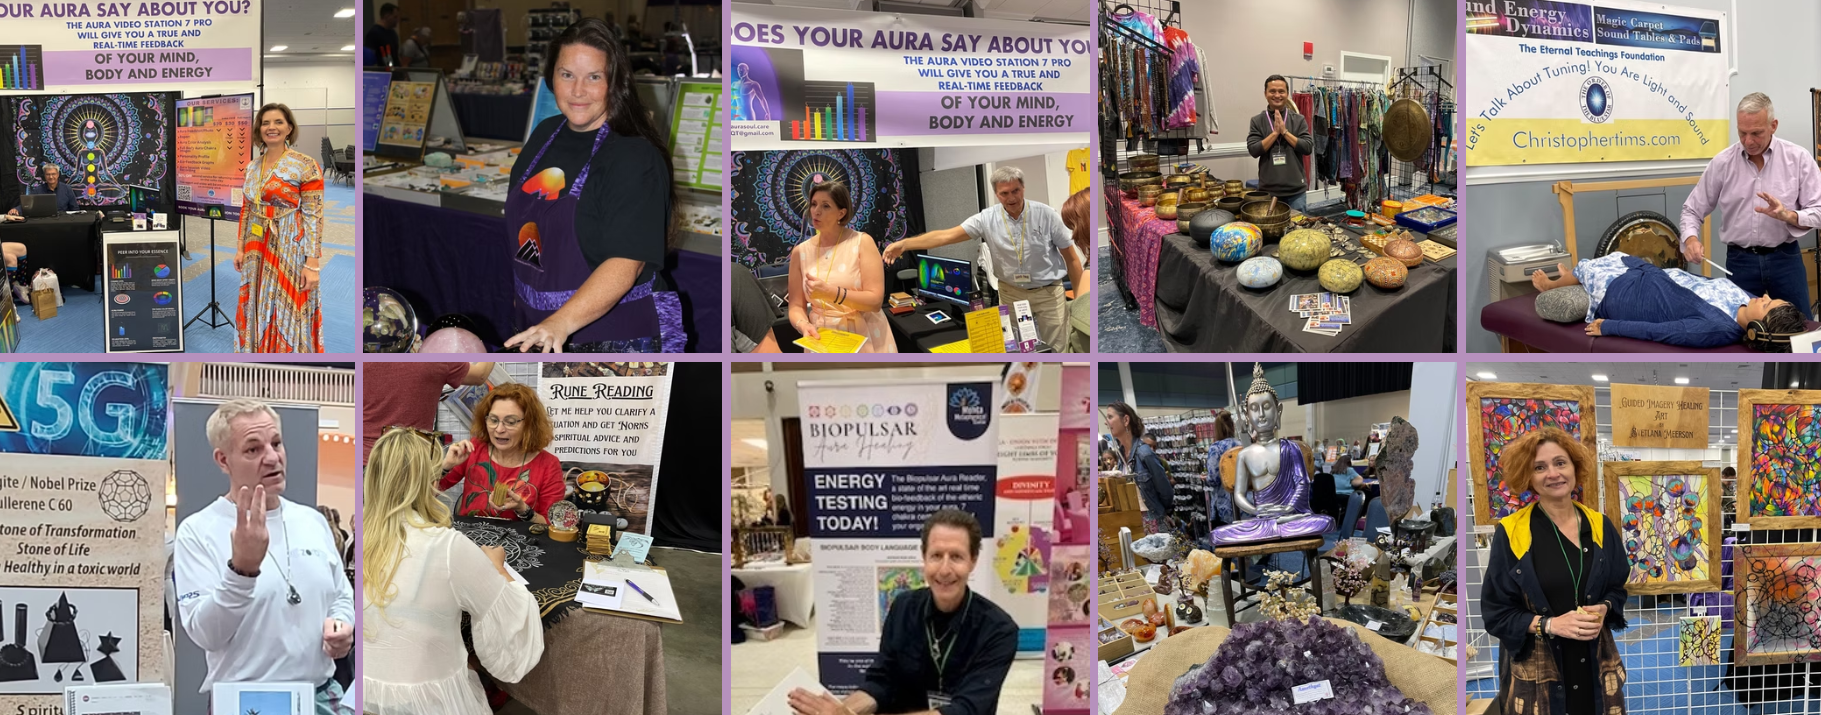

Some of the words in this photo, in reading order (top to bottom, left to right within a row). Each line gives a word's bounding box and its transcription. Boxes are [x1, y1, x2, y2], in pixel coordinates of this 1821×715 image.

[40, 3, 91, 17] AURA
[97, 3, 131, 17] SAY
[137, 2, 197, 16] ABOUT
[203, 0, 251, 14] YOU?
[1504, 0, 1566, 24] Energy
[114, 21, 142, 29] VIDEO
[145, 20, 182, 28] STATION
[1506, 17, 1589, 38] Dynamics
[1596, 14, 1627, 28] Magic
[1630, 18, 1663, 31] Carpet
[101, 31, 122, 39] GIVE
[157, 30, 178, 38] TRUE
[731, 22, 785, 44] OES
[793, 26, 863, 48] YOUR
[871, 30, 933, 51] AURA
[941, 33, 982, 53] SAY
[987, 36, 1052, 54] ABOUT
[1597, 27, 1629, 40] Sound
[1632, 31, 1665, 42] Tables
[1668, 34, 1676, 43] &
[1679, 34, 1700, 46] Pads
[93, 41, 138, 49] REAL-TIME
[141, 40, 184, 48] FEEDBACK
[95, 53, 112, 64] OF
[117, 53, 155, 64] YOUR
[160, 52, 199, 64] MIND,
[1519, 44, 1537, 53] The
[1540, 45, 1572, 55] Eternal
[1576, 47, 1618, 60] Teachings
[1621, 51, 1665, 61] Foundation
[903, 56, 923, 65] THE
[927, 57, 957, 66] AURA
[960, 57, 993, 66] VIDEO
[996, 58, 1039, 67] STATION
[1051, 59, 1071, 67] PRO
[86, 69, 123, 80] BODY
[128, 68, 157, 79] AND
[162, 67, 213, 78] ENERGY
[918, 69, 944, 77] WILL
[947, 69, 971, 78] GIVE
[975, 70, 997, 78] YOU
[1001, 70, 1009, 78] A
[1011, 70, 1036, 78] TRUE
[1039, 70, 1060, 78] AND
[938, 82, 991, 90] REAL-TIME
[994, 82, 1043, 90] FEEDBACK
[941, 96, 962, 109] OF
[967, 96, 1011, 109] YOUR
[1016, 96, 1060, 111] MIND,
[1466, 123, 1485, 151] Let's
[1479, 97, 1507, 121] Talk
[1507, 73, 1542, 101] About
[1543, 60, 1590, 79] Tuning!
[1594, 60, 1617, 74] You
[1620, 66, 1640, 81] Are
[1643, 75, 1667, 96] Light
[1668, 95, 1687, 113] and
[1685, 111, 1709, 145] Sound
[929, 115, 975, 129] BODY
[979, 115, 1013, 128] AND
[1019, 115, 1074, 127] ENERGY
[1513, 131, 1680, 151] Christophertims.com
[31, 370, 136, 447] 5G
[561, 407, 572, 415] ME
[575, 407, 593, 416] HELP
[596, 408, 612, 416] YOU
[615, 408, 648, 416] CLARIFY
[650, 408, 656, 416] A
[582, 421, 598, 429] AND
[600, 421, 615, 429] GET
[618, 421, 649, 431] NORNS
[810, 422, 918, 438] BIOPULSAR
[555, 434, 591, 442] SPIRITUAL
[593, 435, 620, 443] ADVICE
[554, 446, 600, 455] PREDICTIONS
[603, 448, 618, 456] FOR
[621, 449, 637, 457] YOU
[0, 475, 19, 490] ite
[30, 476, 64, 490] Nobel
[68, 478, 96, 491] Prize
[814, 474, 885, 489] ENERGY
[891, 474, 905, 483] The
[941, 474, 958, 482] Aura
[1012, 481, 1050, 489] DIVINITY
[815, 495, 888, 510] TESTING
[29, 523, 43, 536] of
[45, 524, 136, 539] Transformation
[817, 516, 878, 531] TODAY!
[16, 542, 51, 555] Stone
[53, 543, 68, 556] of
[69, 543, 90, 556] Life
[4, 560, 51, 577] Healthy
[53, 561, 64, 574] in
[67, 563, 74, 575] a
[78, 562, 105, 575] toxic
[108, 563, 141, 576] world
